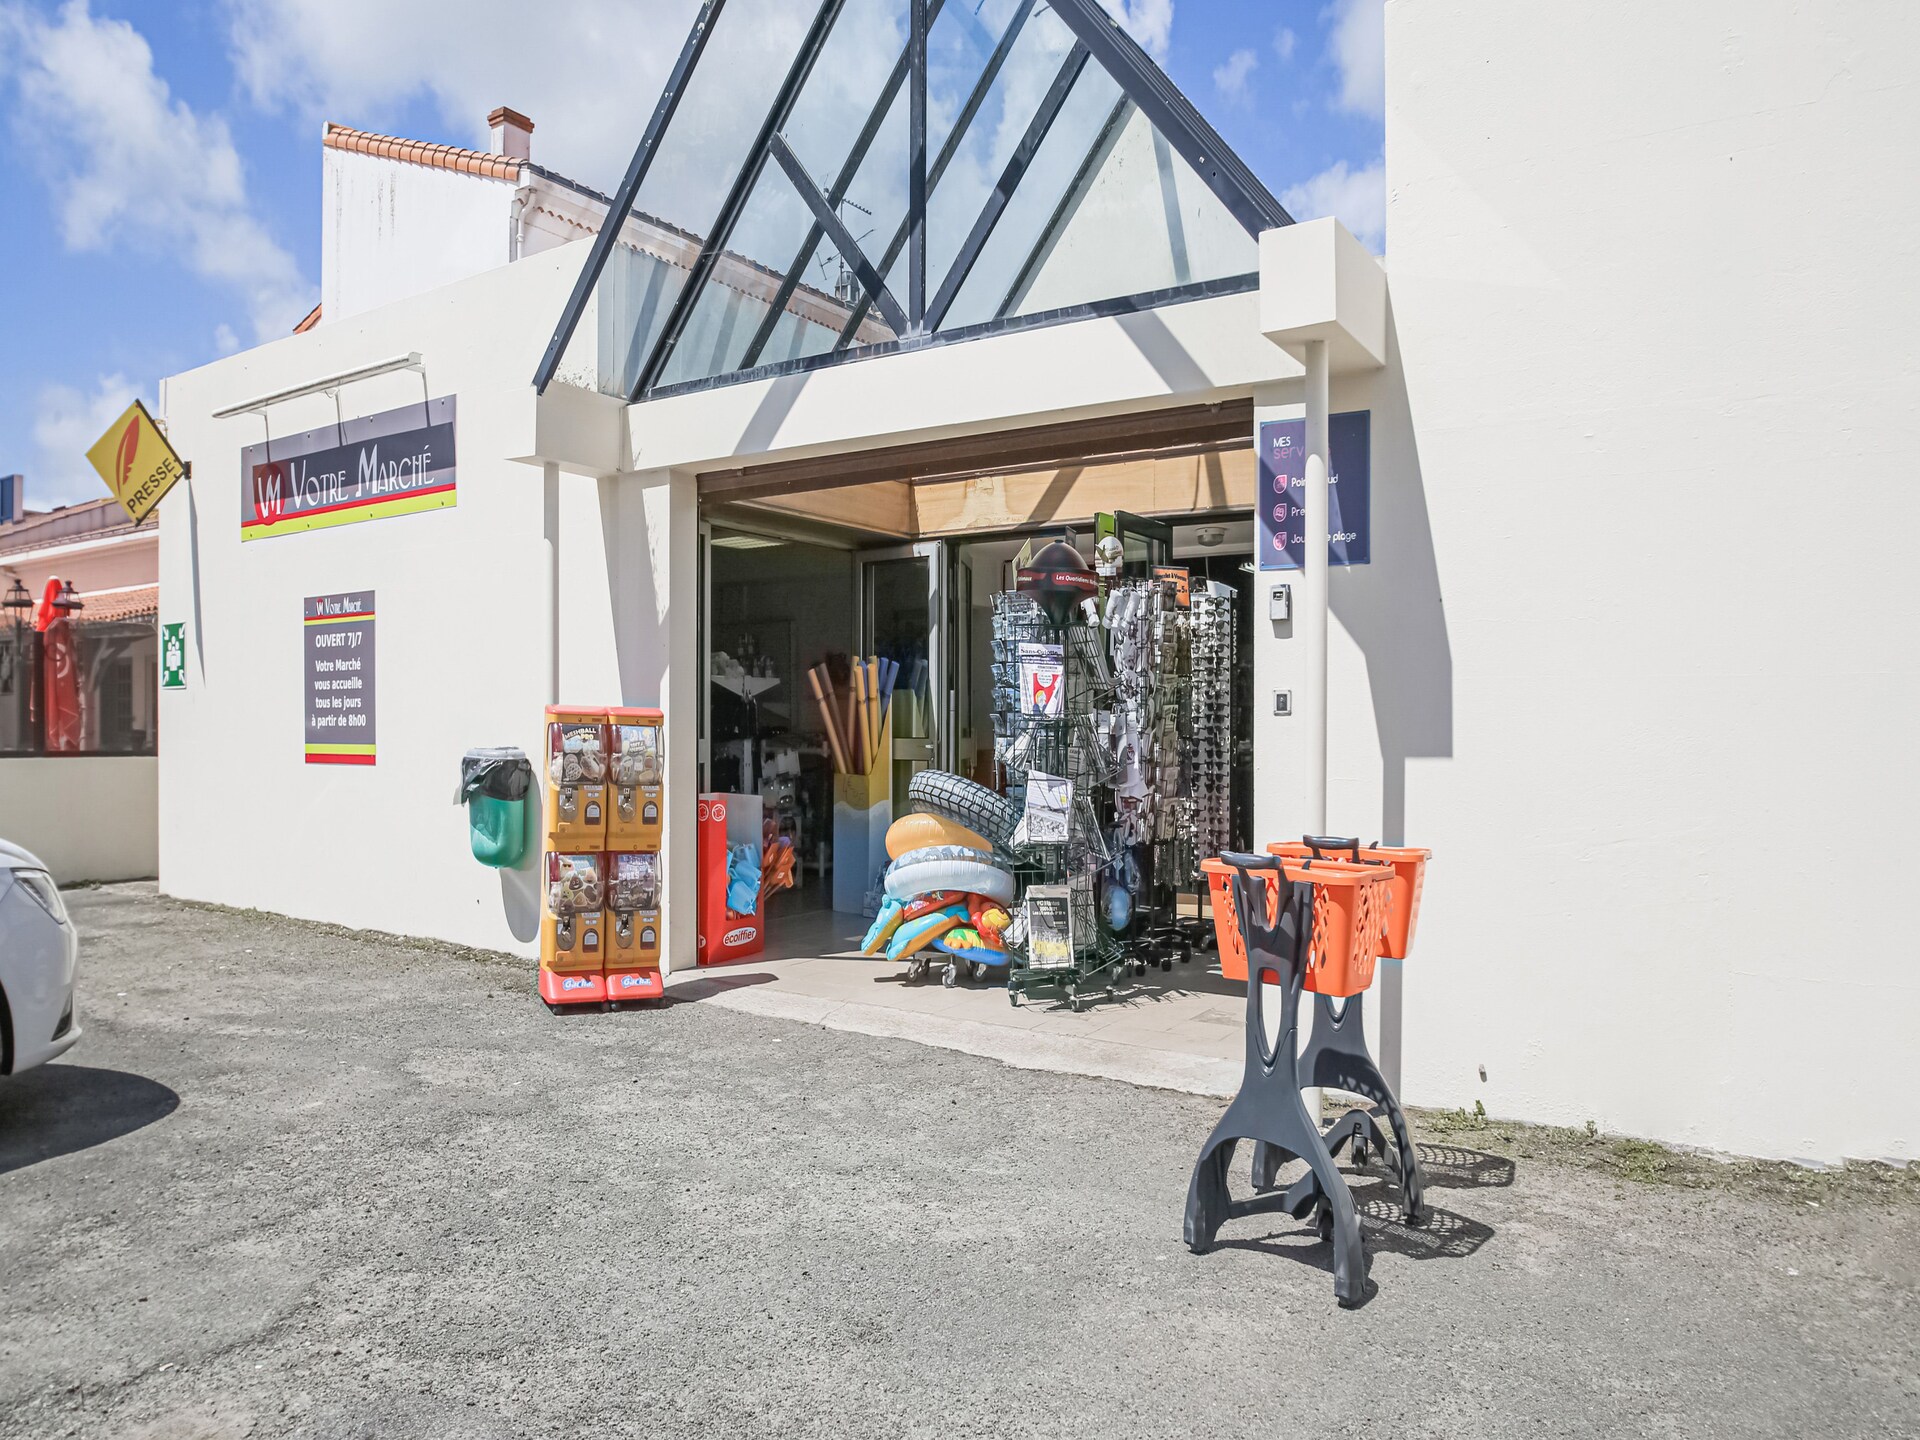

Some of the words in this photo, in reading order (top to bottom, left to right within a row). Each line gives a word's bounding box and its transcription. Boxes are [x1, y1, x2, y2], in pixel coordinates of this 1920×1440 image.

[1273, 437, 1291, 447] MES
[1273, 446, 1305, 459] serv
[127, 457, 175, 514] PRESSE
[1291, 507, 1306, 517] Pre
[1332, 530, 1357, 543] plage
[315, 633, 346, 648] OUVERT
[347, 632, 362, 648] 7J/7
[315, 660, 334, 671] Votre
[335, 657, 361, 671] Marché
[314, 680, 331, 690] vous
[332, 677, 362, 690] accueille
[315, 696, 331, 708] tous
[332, 696, 342, 708] les
[343, 696, 361, 711] jours
[311, 713, 316, 726] à
[317, 714, 336, 729] partir
[338, 714, 347, 726] de
[348, 714, 366, 726] 8h00
[725, 930, 755, 944] écoiffier
